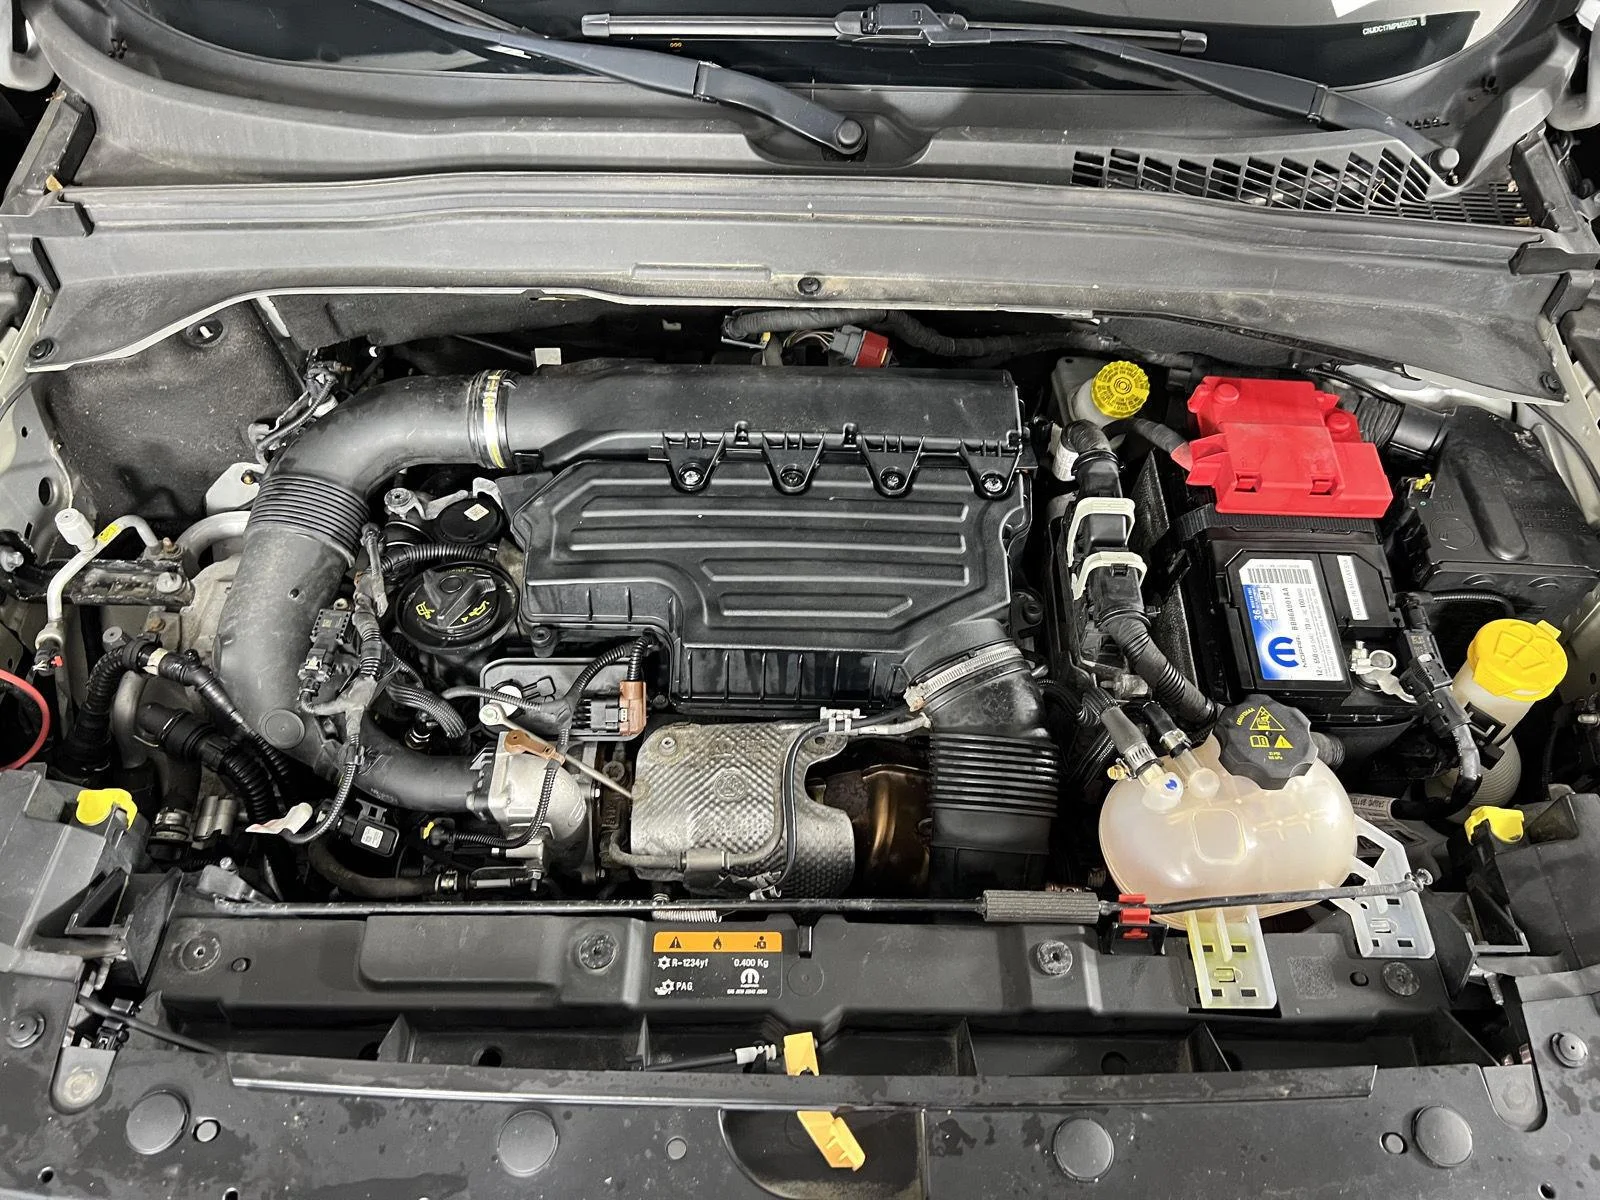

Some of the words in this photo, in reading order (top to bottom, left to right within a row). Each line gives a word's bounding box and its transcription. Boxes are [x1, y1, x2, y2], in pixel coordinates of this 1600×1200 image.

[1253, 609, 1262, 619] 36
[672, 958, 708, 968] R-1234yf
[734, 958, 756, 967] 0.400
[757, 958, 769, 968] Kg
[676, 982, 693, 990] PAG
